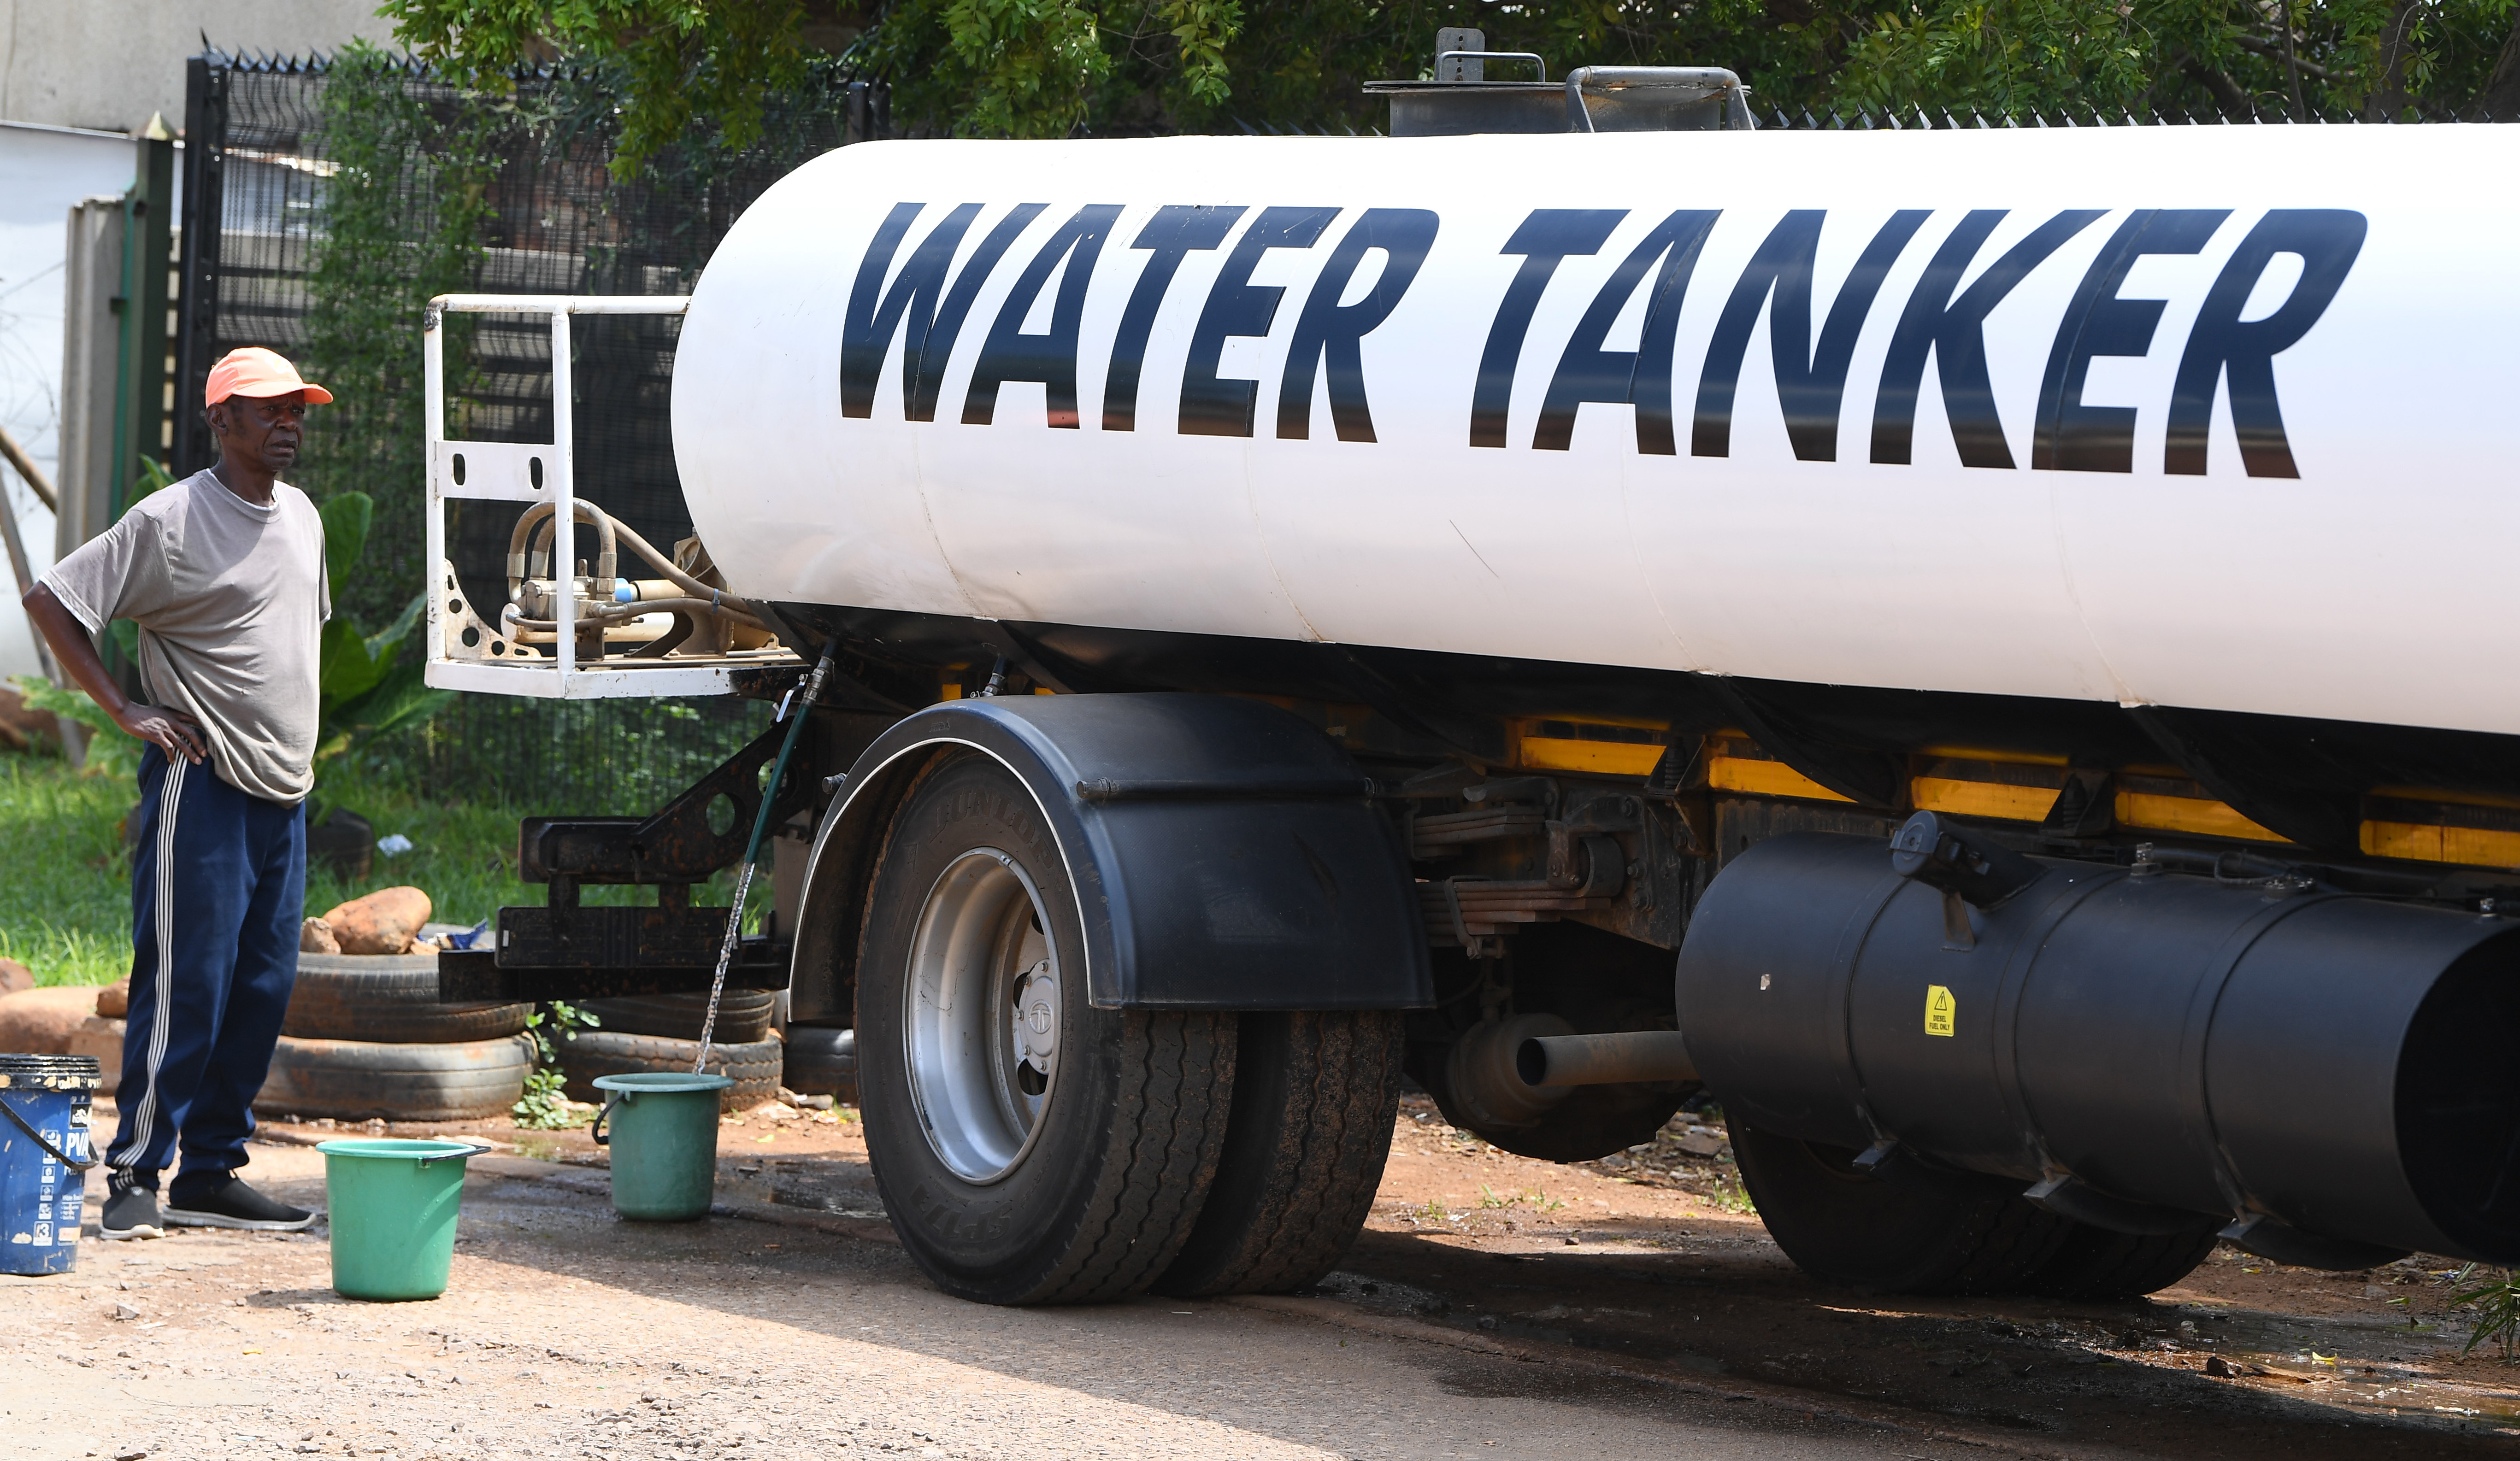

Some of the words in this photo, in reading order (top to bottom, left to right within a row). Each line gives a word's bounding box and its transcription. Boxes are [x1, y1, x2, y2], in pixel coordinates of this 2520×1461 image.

[840, 202, 1440, 443] WATER
[1469, 209, 2368, 480] TANKER
[930, 786, 1054, 869] DUNLOP
[65, 1132, 89, 1157] PVA
